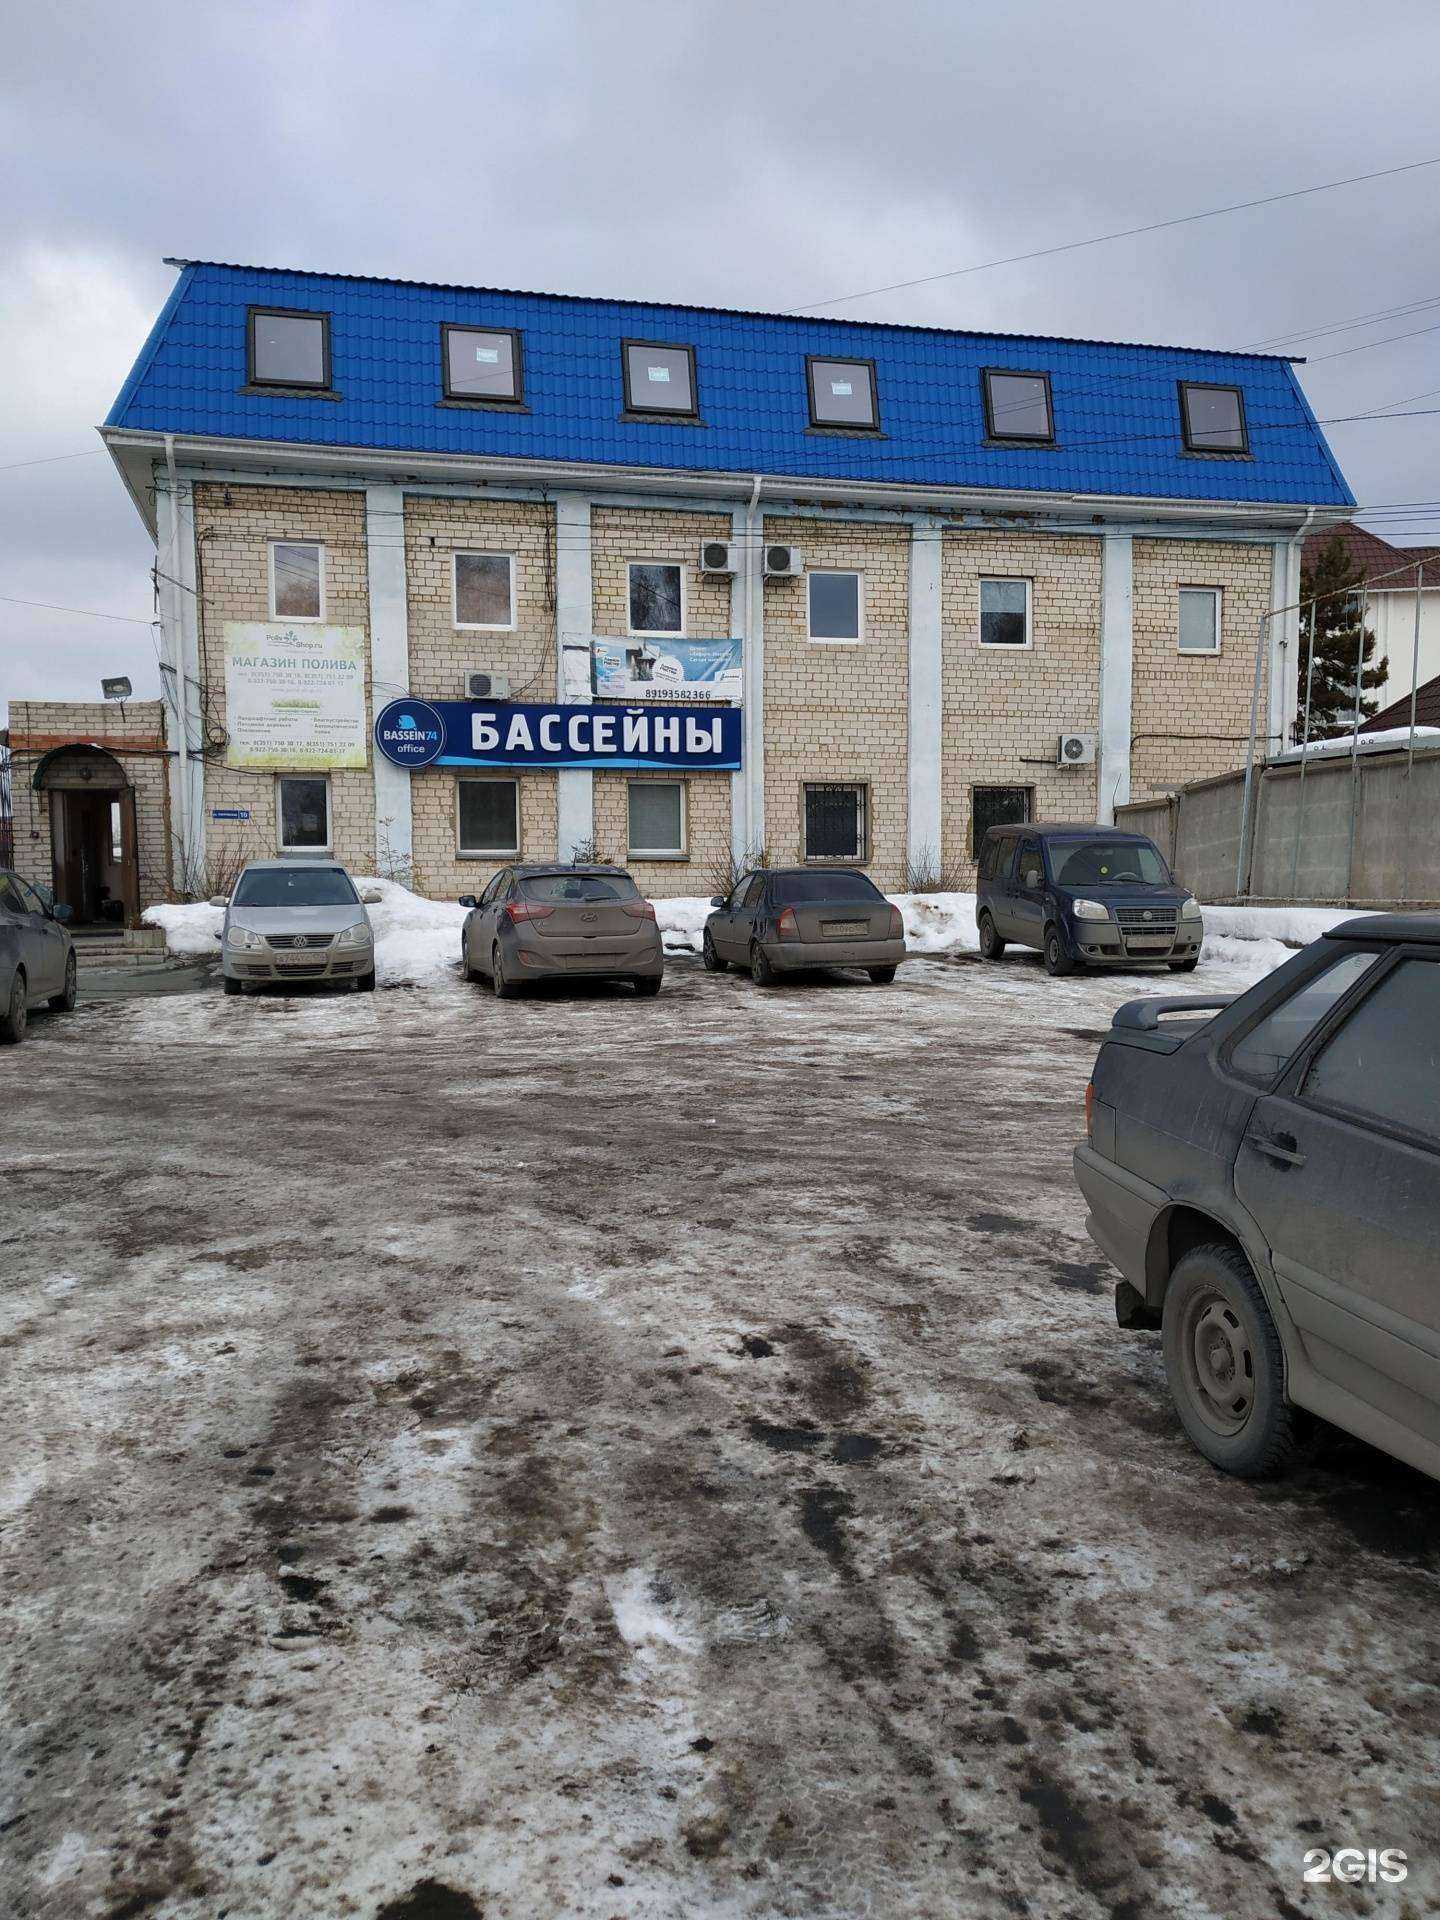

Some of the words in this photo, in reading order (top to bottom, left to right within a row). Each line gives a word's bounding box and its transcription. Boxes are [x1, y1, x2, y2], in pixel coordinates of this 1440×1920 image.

[232, 656, 296, 669] МАГАЗИН
[302, 659, 357, 671] ПОЛИВА
[645, 689, 711, 700] 89193582366
[471, 708, 723, 754] БАССЕЙНЫ
[397, 744, 425, 753] office
